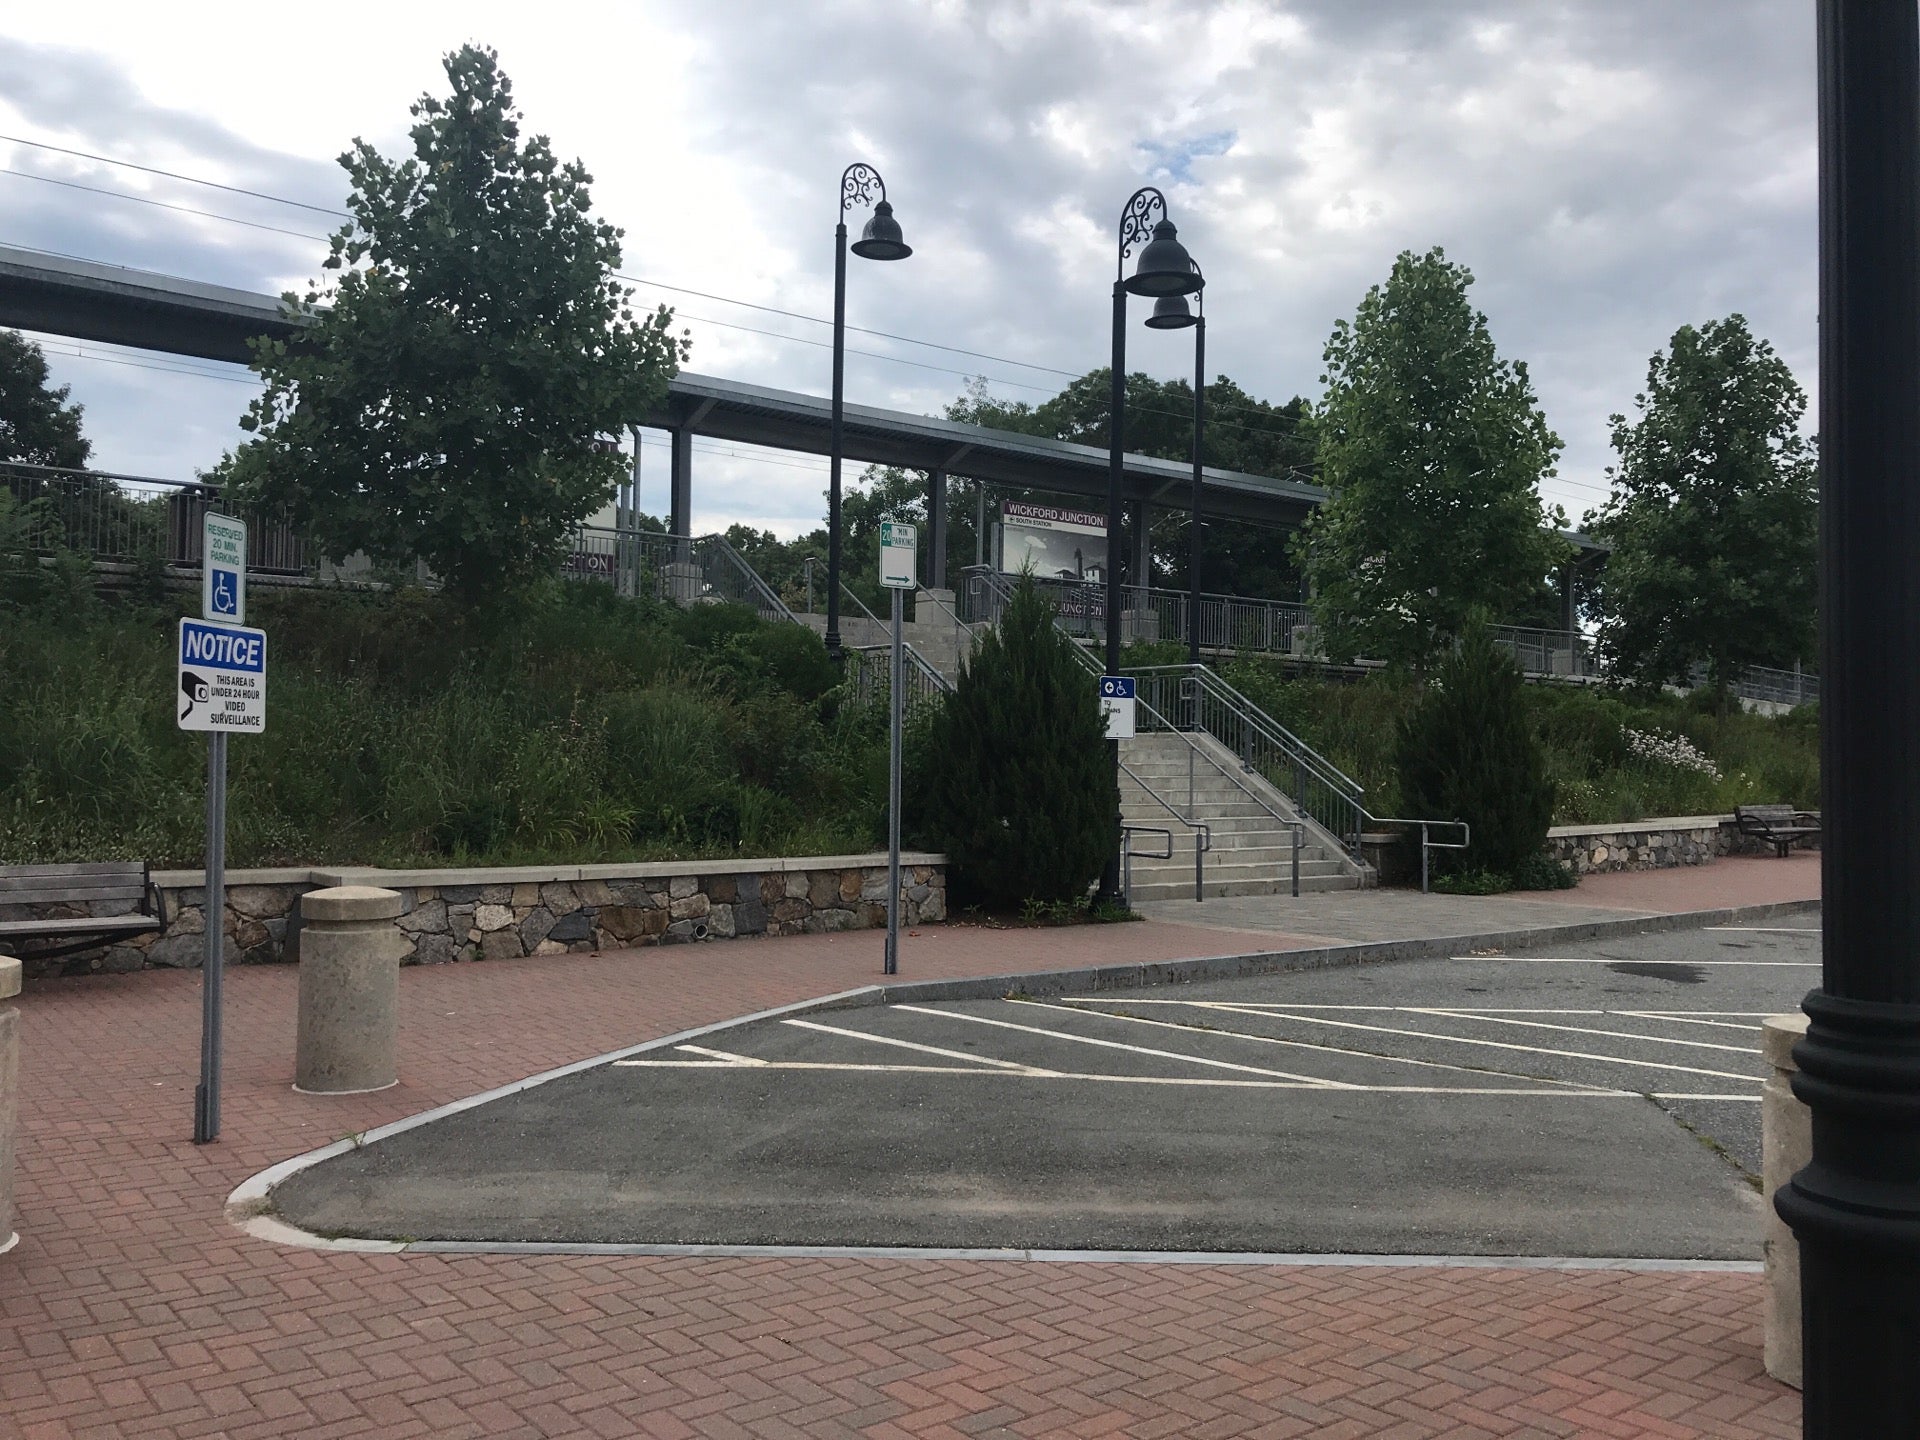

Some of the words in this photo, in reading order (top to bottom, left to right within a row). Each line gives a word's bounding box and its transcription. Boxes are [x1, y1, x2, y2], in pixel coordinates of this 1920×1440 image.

[1008, 503, 1057, 520] WICKFORD
[1059, 511, 1104, 527] JUNCTION
[1015, 517, 1033, 525] SOUTH
[1033, 519, 1052, 528] STATION
[207, 523, 243, 541] RESERVED
[882, 529, 892, 542] 20
[897, 527, 908, 536] MIN
[212, 538, 222, 550] 20
[892, 536, 914, 547] PARKING
[211, 550, 239, 566] PARKING
[185, 630, 261, 667] NOTICE
[216, 674, 231, 685] THIS
[231, 676, 248, 687] AREA
[248, 678, 255, 688] IS
[210, 687, 232, 698] UNDER
[233, 689, 242, 698] 24
[242, 690, 260, 700] HOUR
[224, 700, 246, 712] VIDEO
[210, 713, 261, 727] SURVEILLANCE
